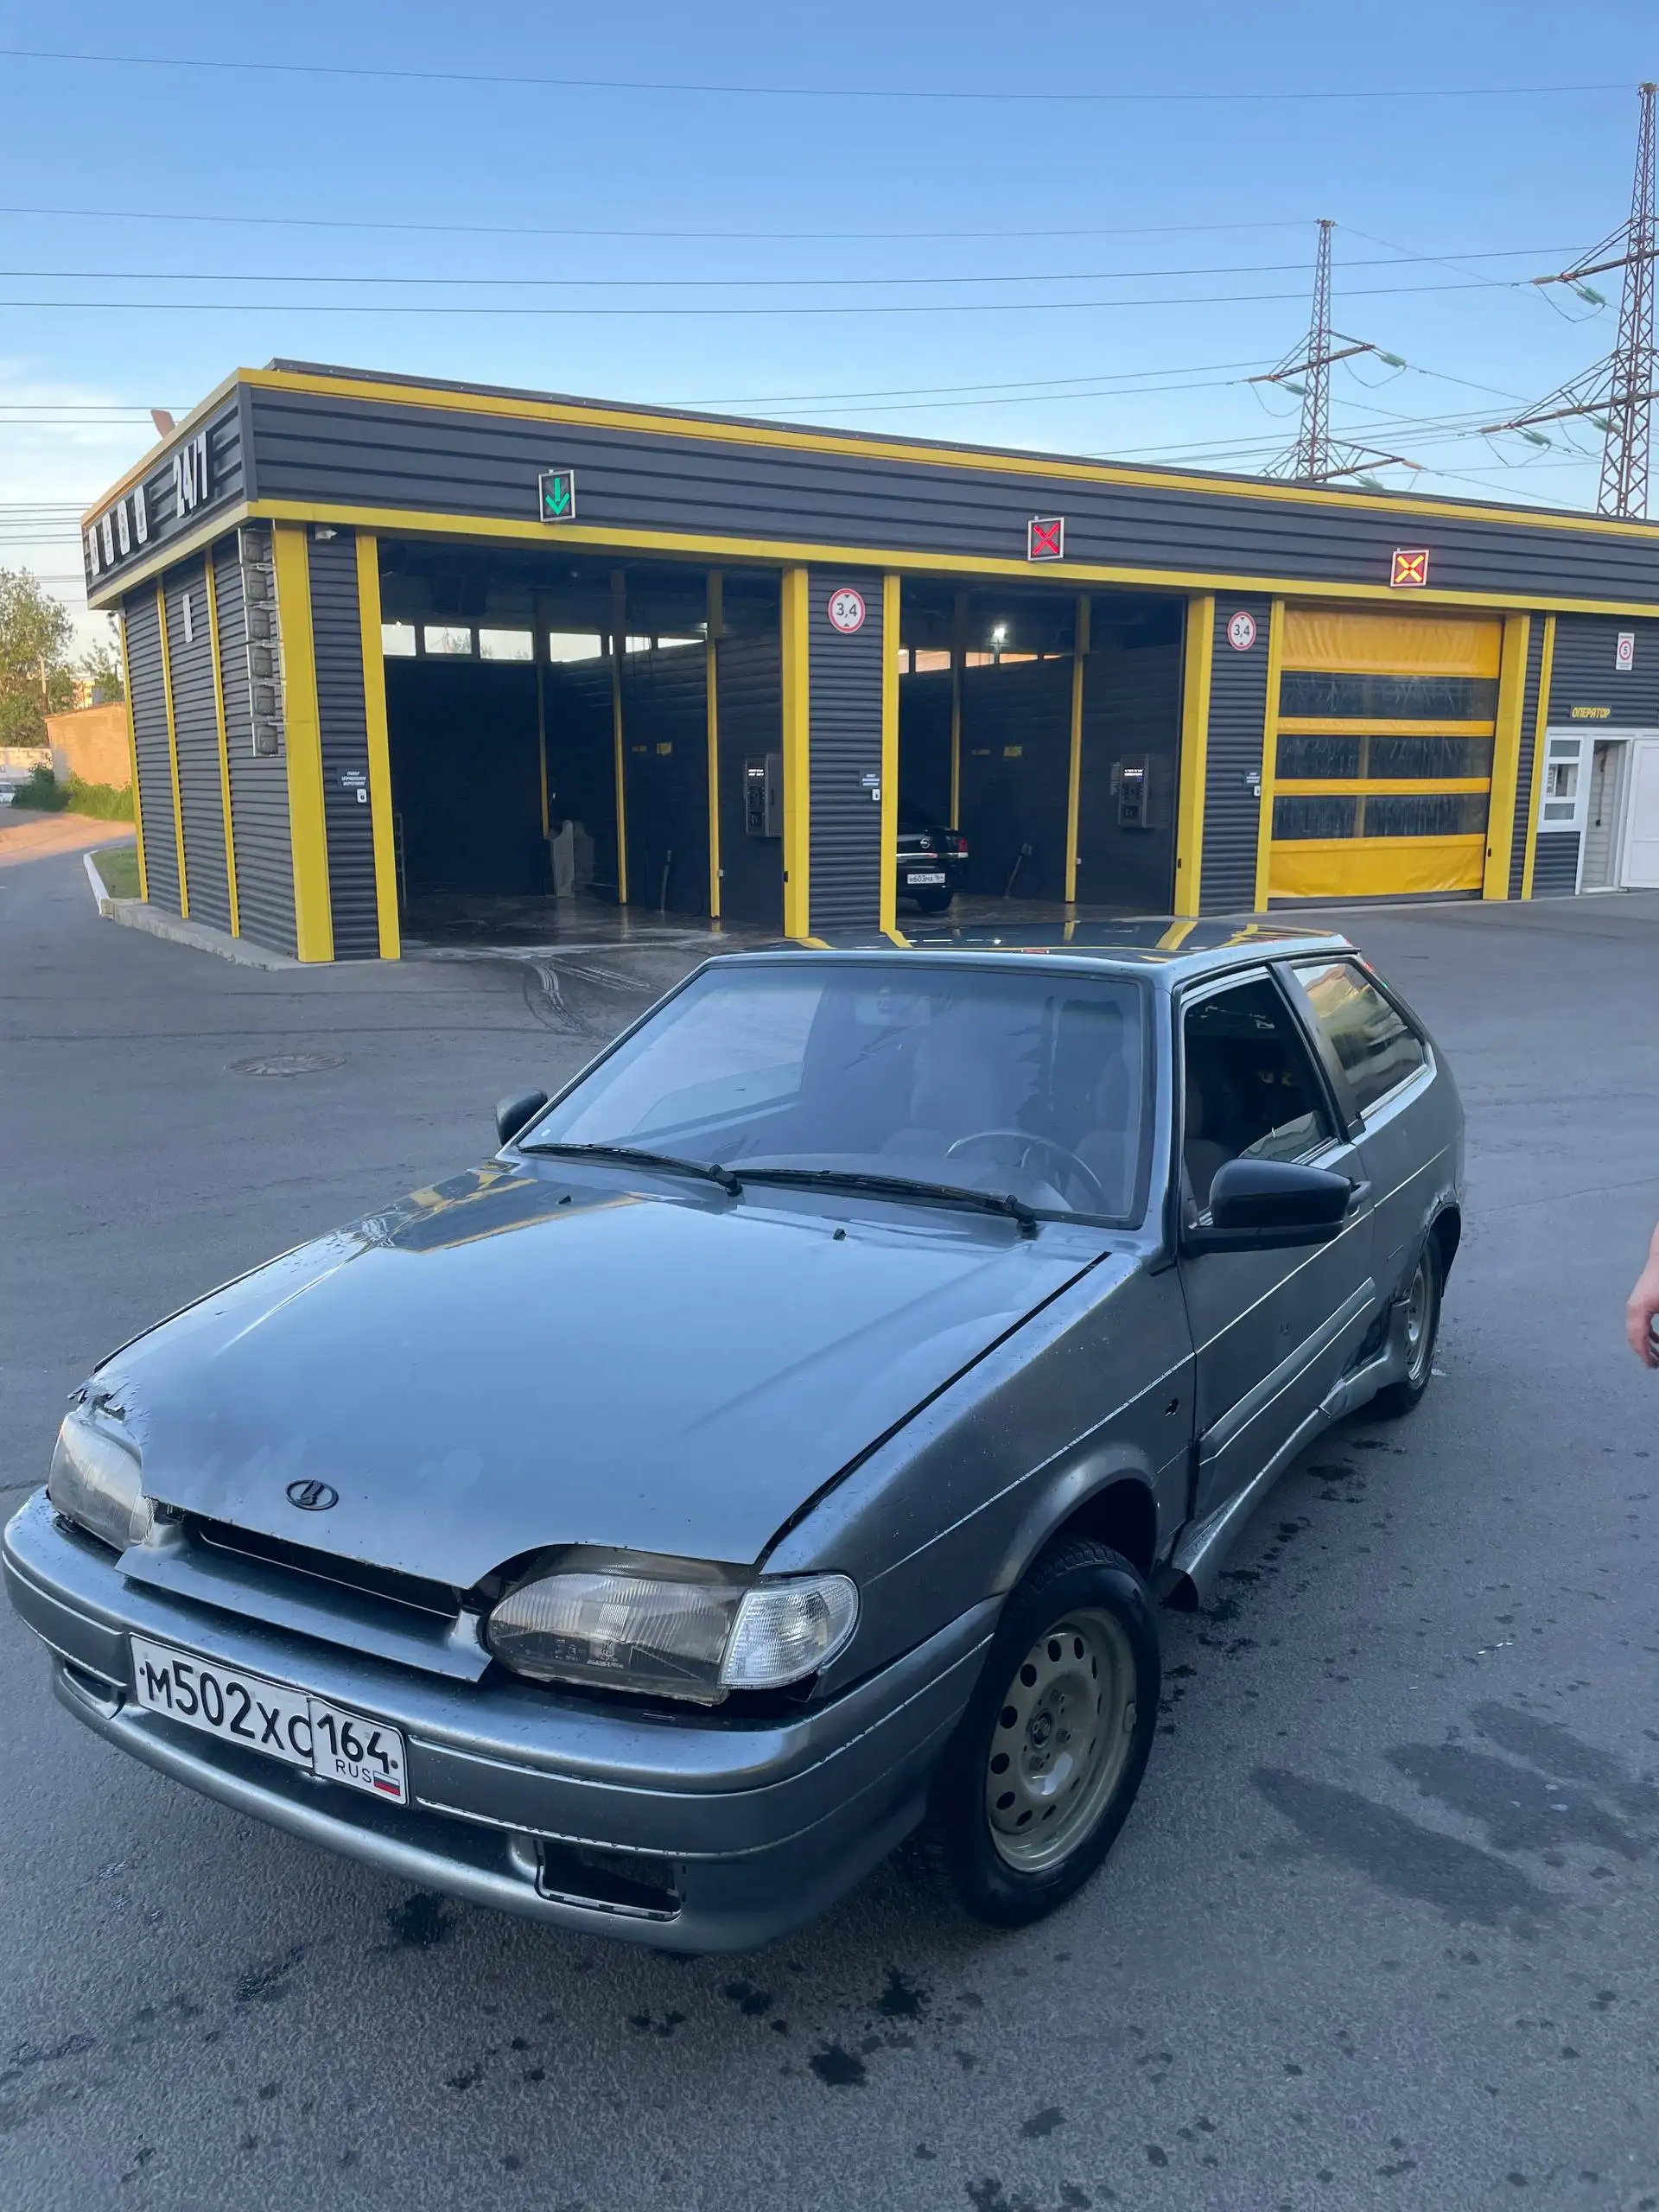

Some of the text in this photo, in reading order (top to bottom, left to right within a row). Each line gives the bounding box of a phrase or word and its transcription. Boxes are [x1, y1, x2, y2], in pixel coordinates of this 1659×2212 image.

[174, 430, 208, 518] 24/7
[836, 602, 857, 619] 3,4
[1233, 624, 1250, 638] 3,4
[316, 1713, 390, 1774] 164
[335, 1758, 372, 1784] RUS
